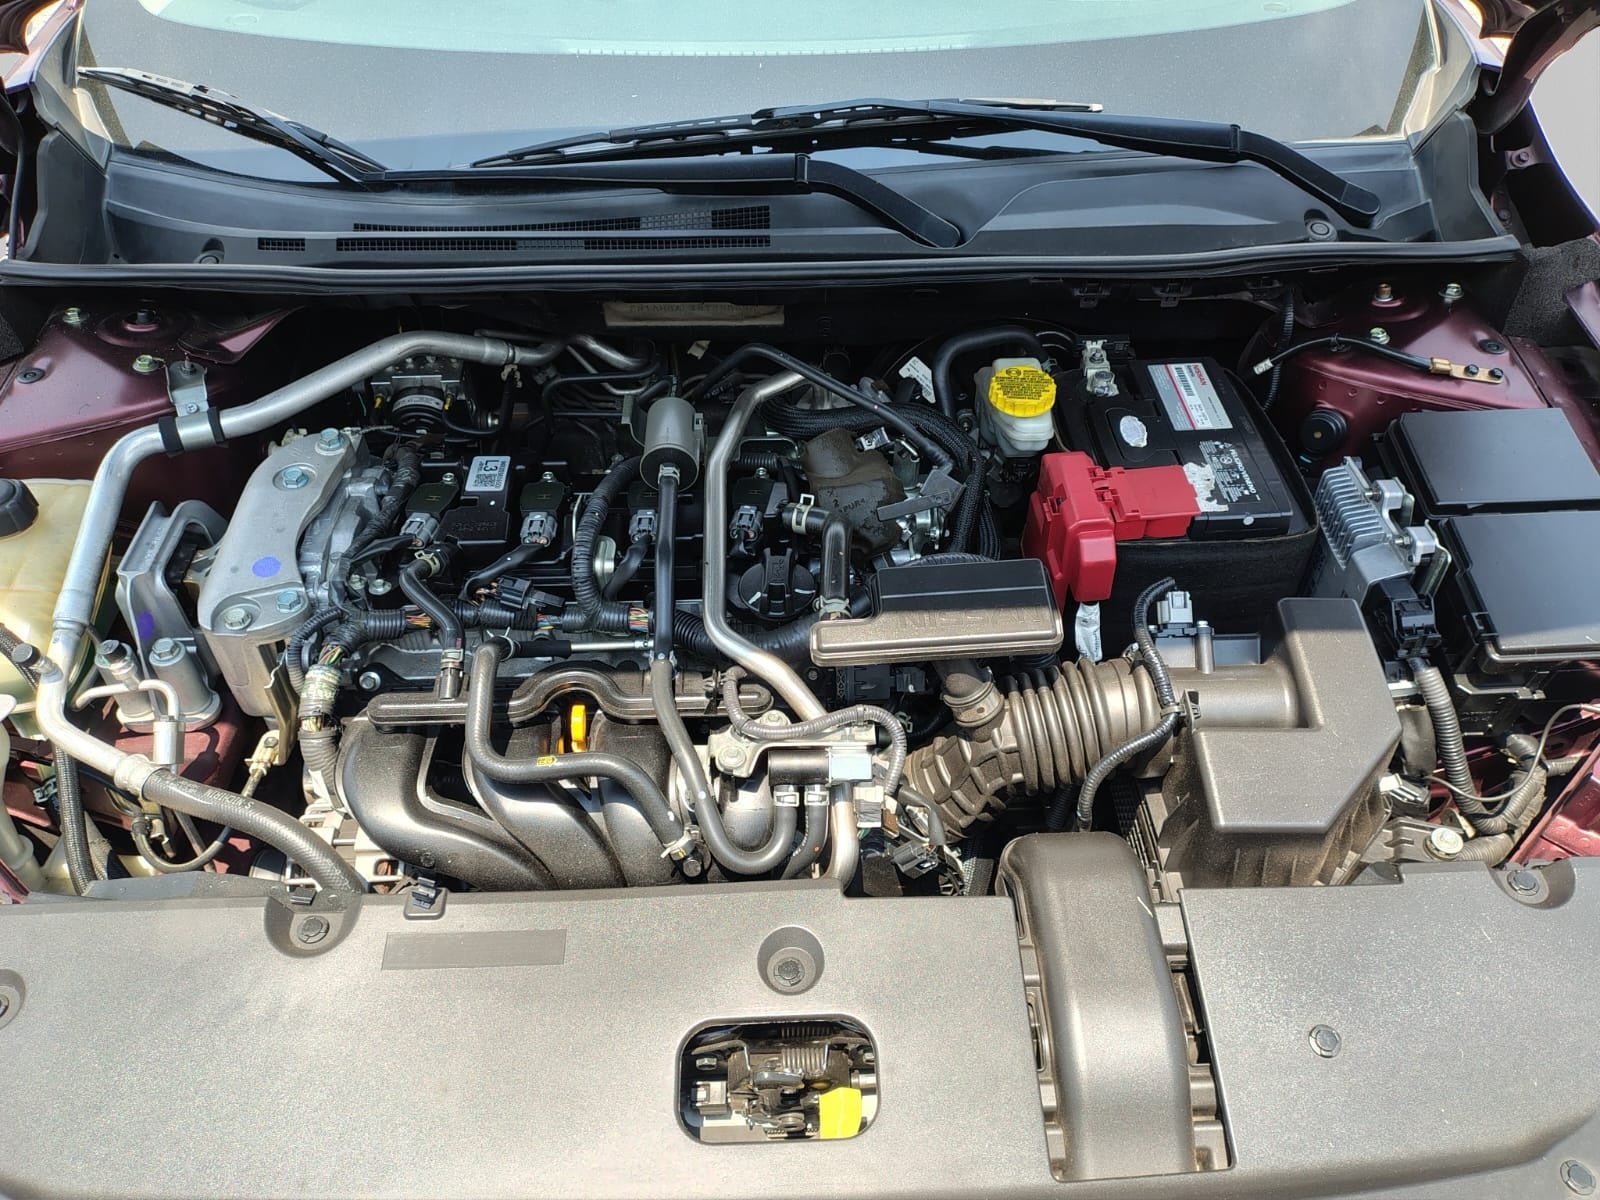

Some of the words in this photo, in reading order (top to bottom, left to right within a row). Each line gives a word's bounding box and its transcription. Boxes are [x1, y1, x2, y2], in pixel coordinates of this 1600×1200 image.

[1192, 364, 1208, 386] NISSAN
[484, 460, 499, 471] L3
[901, 607, 1042, 628] NISSAN
